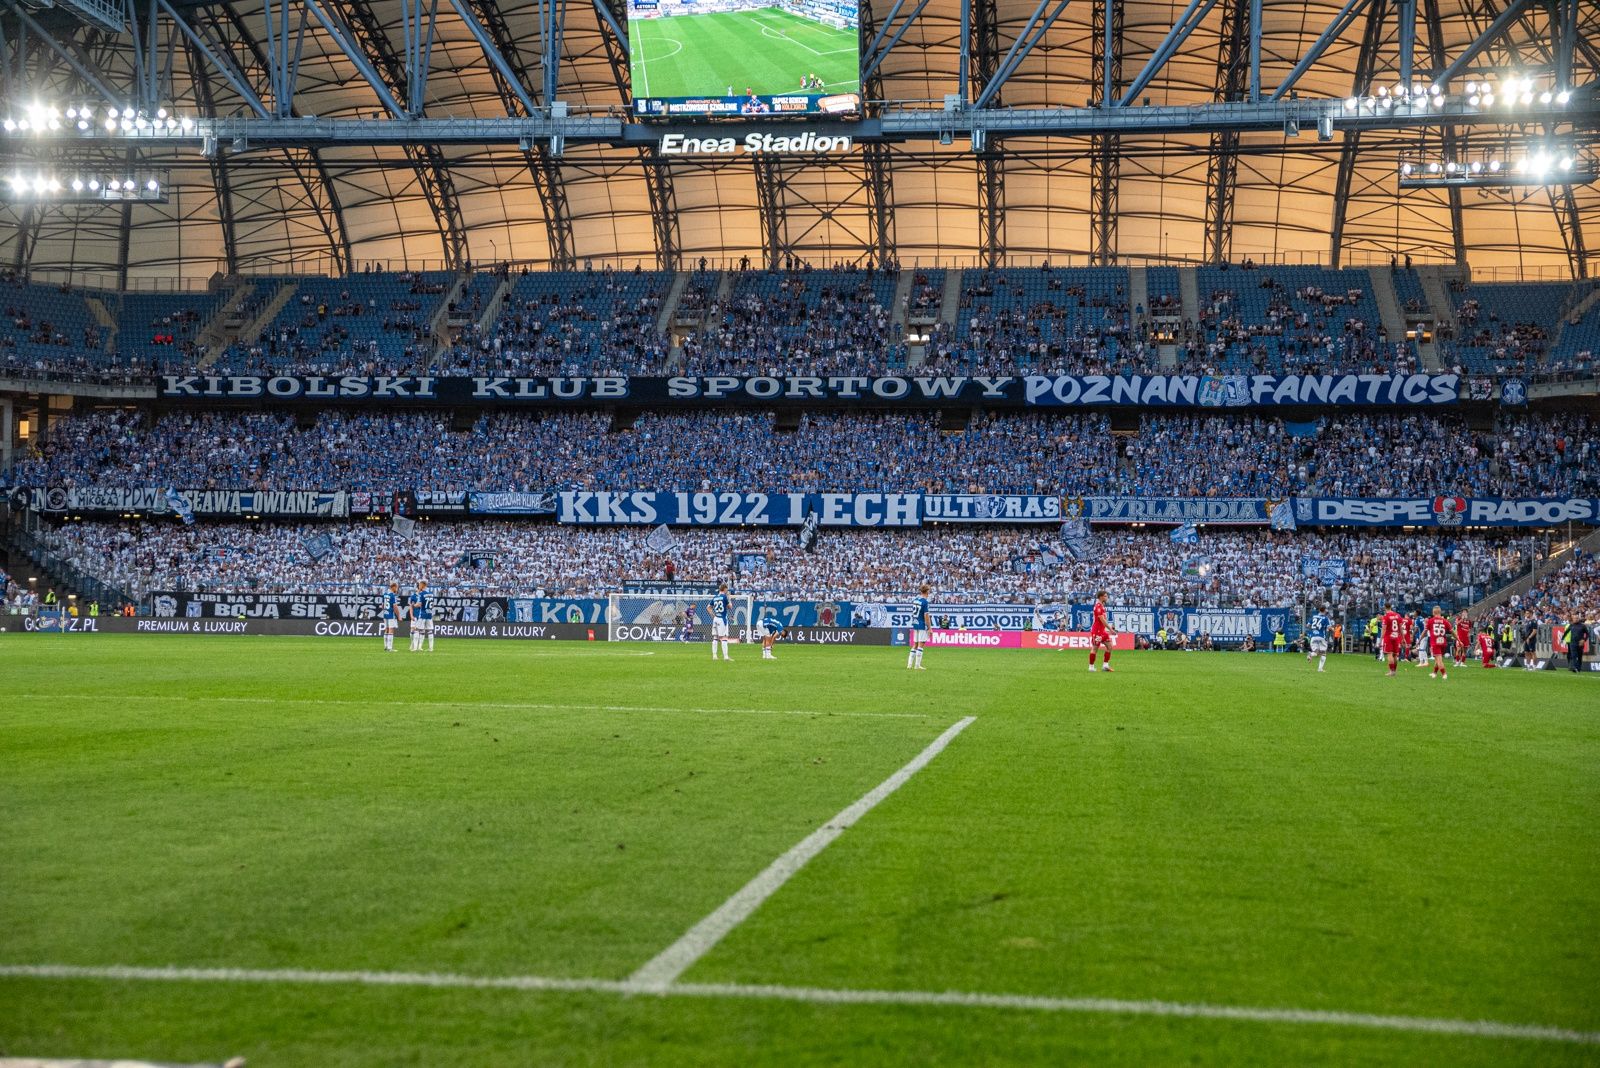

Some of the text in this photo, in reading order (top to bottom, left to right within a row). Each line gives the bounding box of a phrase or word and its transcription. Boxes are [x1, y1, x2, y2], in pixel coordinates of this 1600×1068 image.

[660, 132, 851, 154] Enea Stadion
[162, 375, 1012, 397] KIBOLSKI KLUB SPORTOWY
[1250, 374, 1458, 403] FANATICS
[252, 491, 319, 514] OWIANE
[417, 490, 466, 504] PDW
[559, 491, 657, 523] KKS
[675, 492, 769, 523] 1922
[1091, 500, 1259, 519] PYRLANDIA
[194, 594, 221, 602] LUBI
[227, 595, 254, 603] NAS
[260, 595, 317, 604] NIEWIELU
[326, 596, 401, 605] WIĘKSZO
[714, 600, 724, 613] 23
[912, 605, 921, 618] 27
[138, 621, 189, 631] PREMIUM
[205, 622, 247, 632] LUXURY
[315, 621, 386, 635] GOMEZ.P
[1188, 611, 1260, 635] POZNAŃ
[1312, 618, 1322, 628] 24
[1392, 619, 1398, 631] 8
[434, 625, 546, 637] PREMIUM & LUXURY
[797, 632, 805, 640] &
[810, 631, 855, 642] LUXURY
[1433, 624, 1446, 636] 55
[931, 632, 1000, 645] Multikino
[1037, 633, 1118, 647] SUPERT
